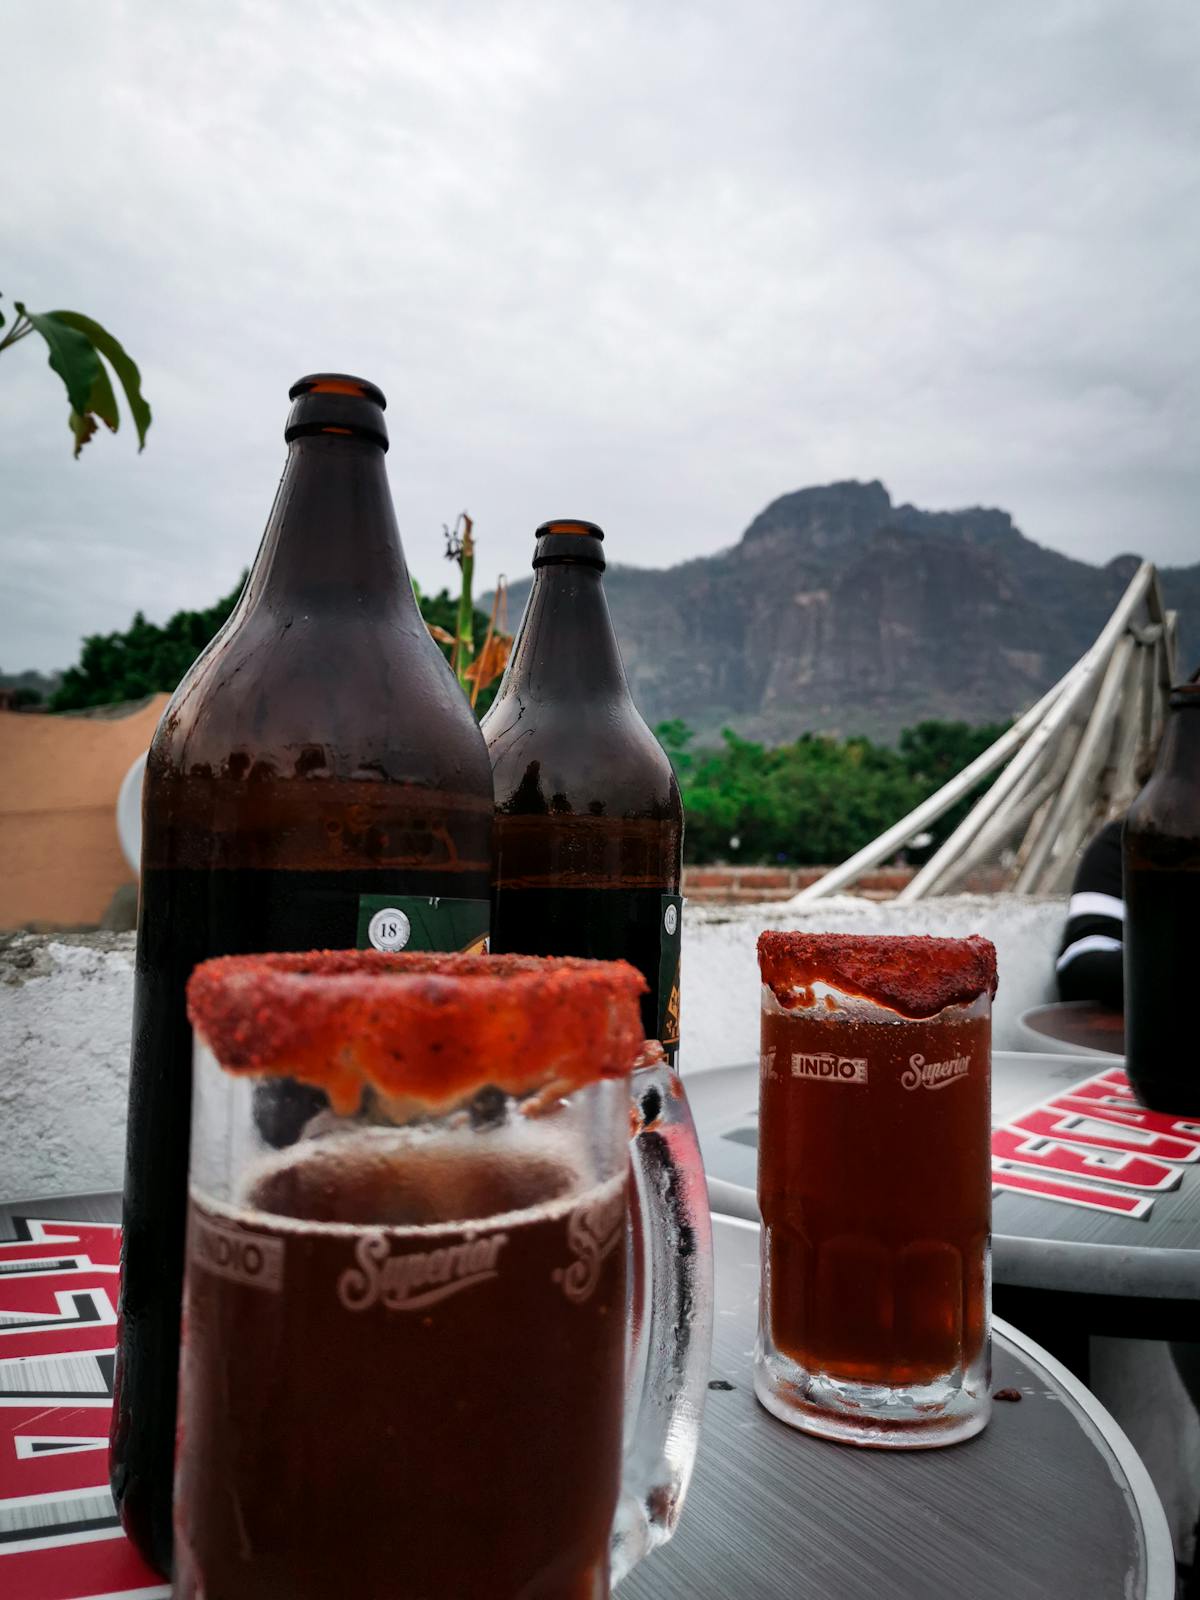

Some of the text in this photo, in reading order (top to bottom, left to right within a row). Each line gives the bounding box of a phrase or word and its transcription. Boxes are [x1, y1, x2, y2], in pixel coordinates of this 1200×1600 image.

[381, 922, 398, 938] 18
[800, 1055, 856, 1079] INDIO
[901, 1052, 972, 1091] Superior
[990, 1066, 1200, 1219] TECA
[337, 1232, 510, 1311] Superior
